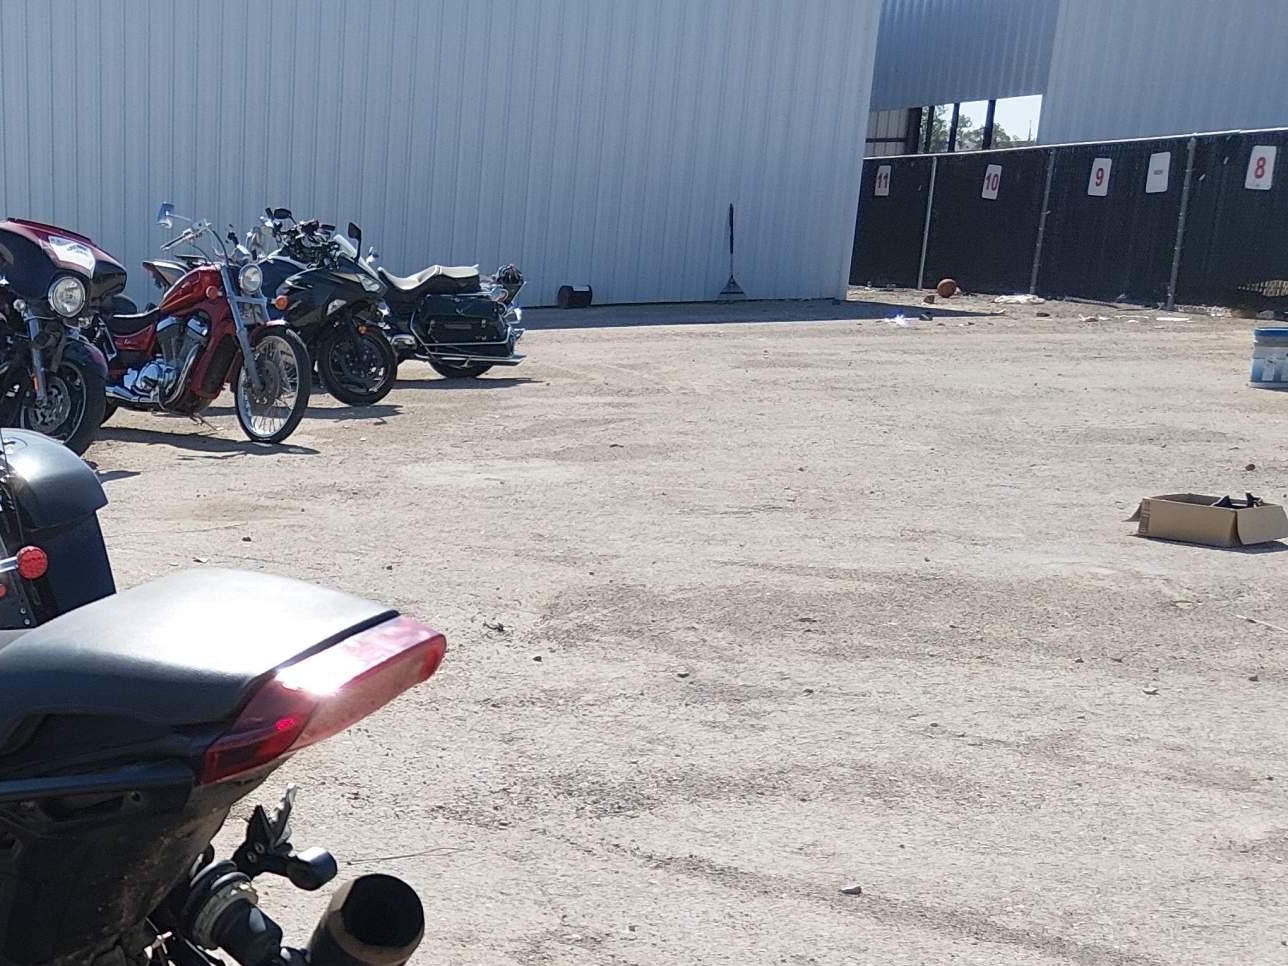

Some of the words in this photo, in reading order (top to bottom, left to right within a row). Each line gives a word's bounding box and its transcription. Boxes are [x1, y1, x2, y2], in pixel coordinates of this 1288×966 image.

[1095, 167, 1104, 187] 9
[1254, 156, 1266, 179] 8
[878, 173, 888, 188] 11
[986, 173, 999, 191] 10
